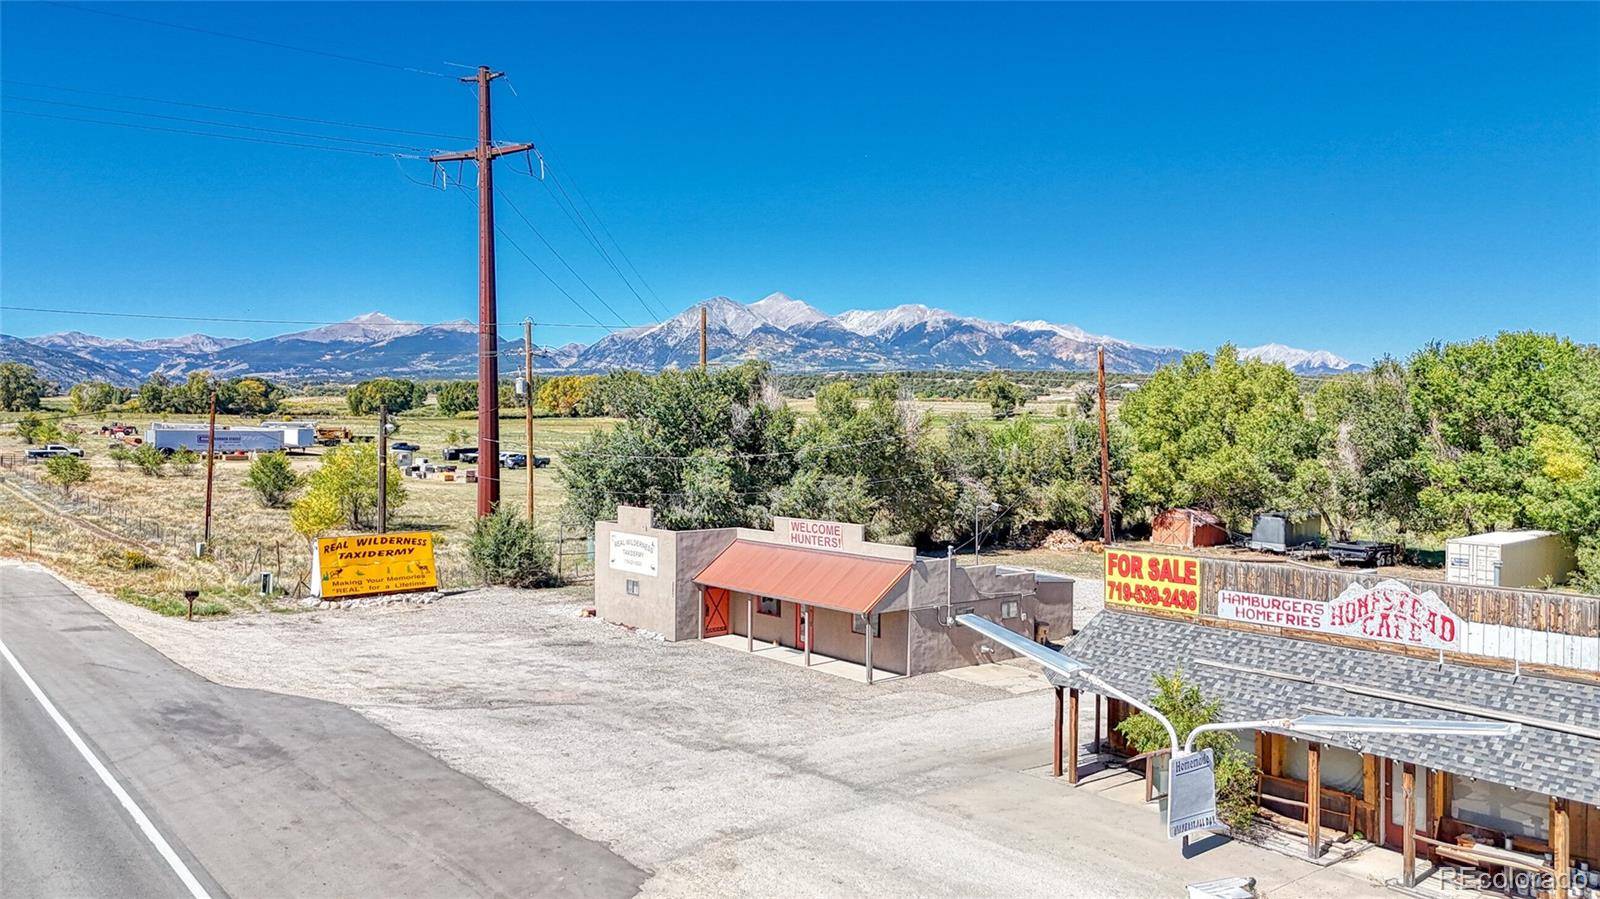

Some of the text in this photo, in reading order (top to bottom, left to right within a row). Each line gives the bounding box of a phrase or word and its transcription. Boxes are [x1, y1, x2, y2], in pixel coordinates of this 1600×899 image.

[791, 521, 840, 536] WELCOME
[324, 536, 427, 554] REAL WILDERNESS
[791, 533, 841, 548] HUNTERS!
[338, 547, 415, 560] TAXIDERMY
[387, 574, 426, 582] Memories
[1108, 553, 1197, 585] FOR SALE
[1107, 581, 1197, 611] 719-539-2436
[1222, 592, 1325, 616] HAMBURGERS
[1235, 606, 1321, 628] HOMEFRIES
[1176, 753, 1210, 773] Homemade
